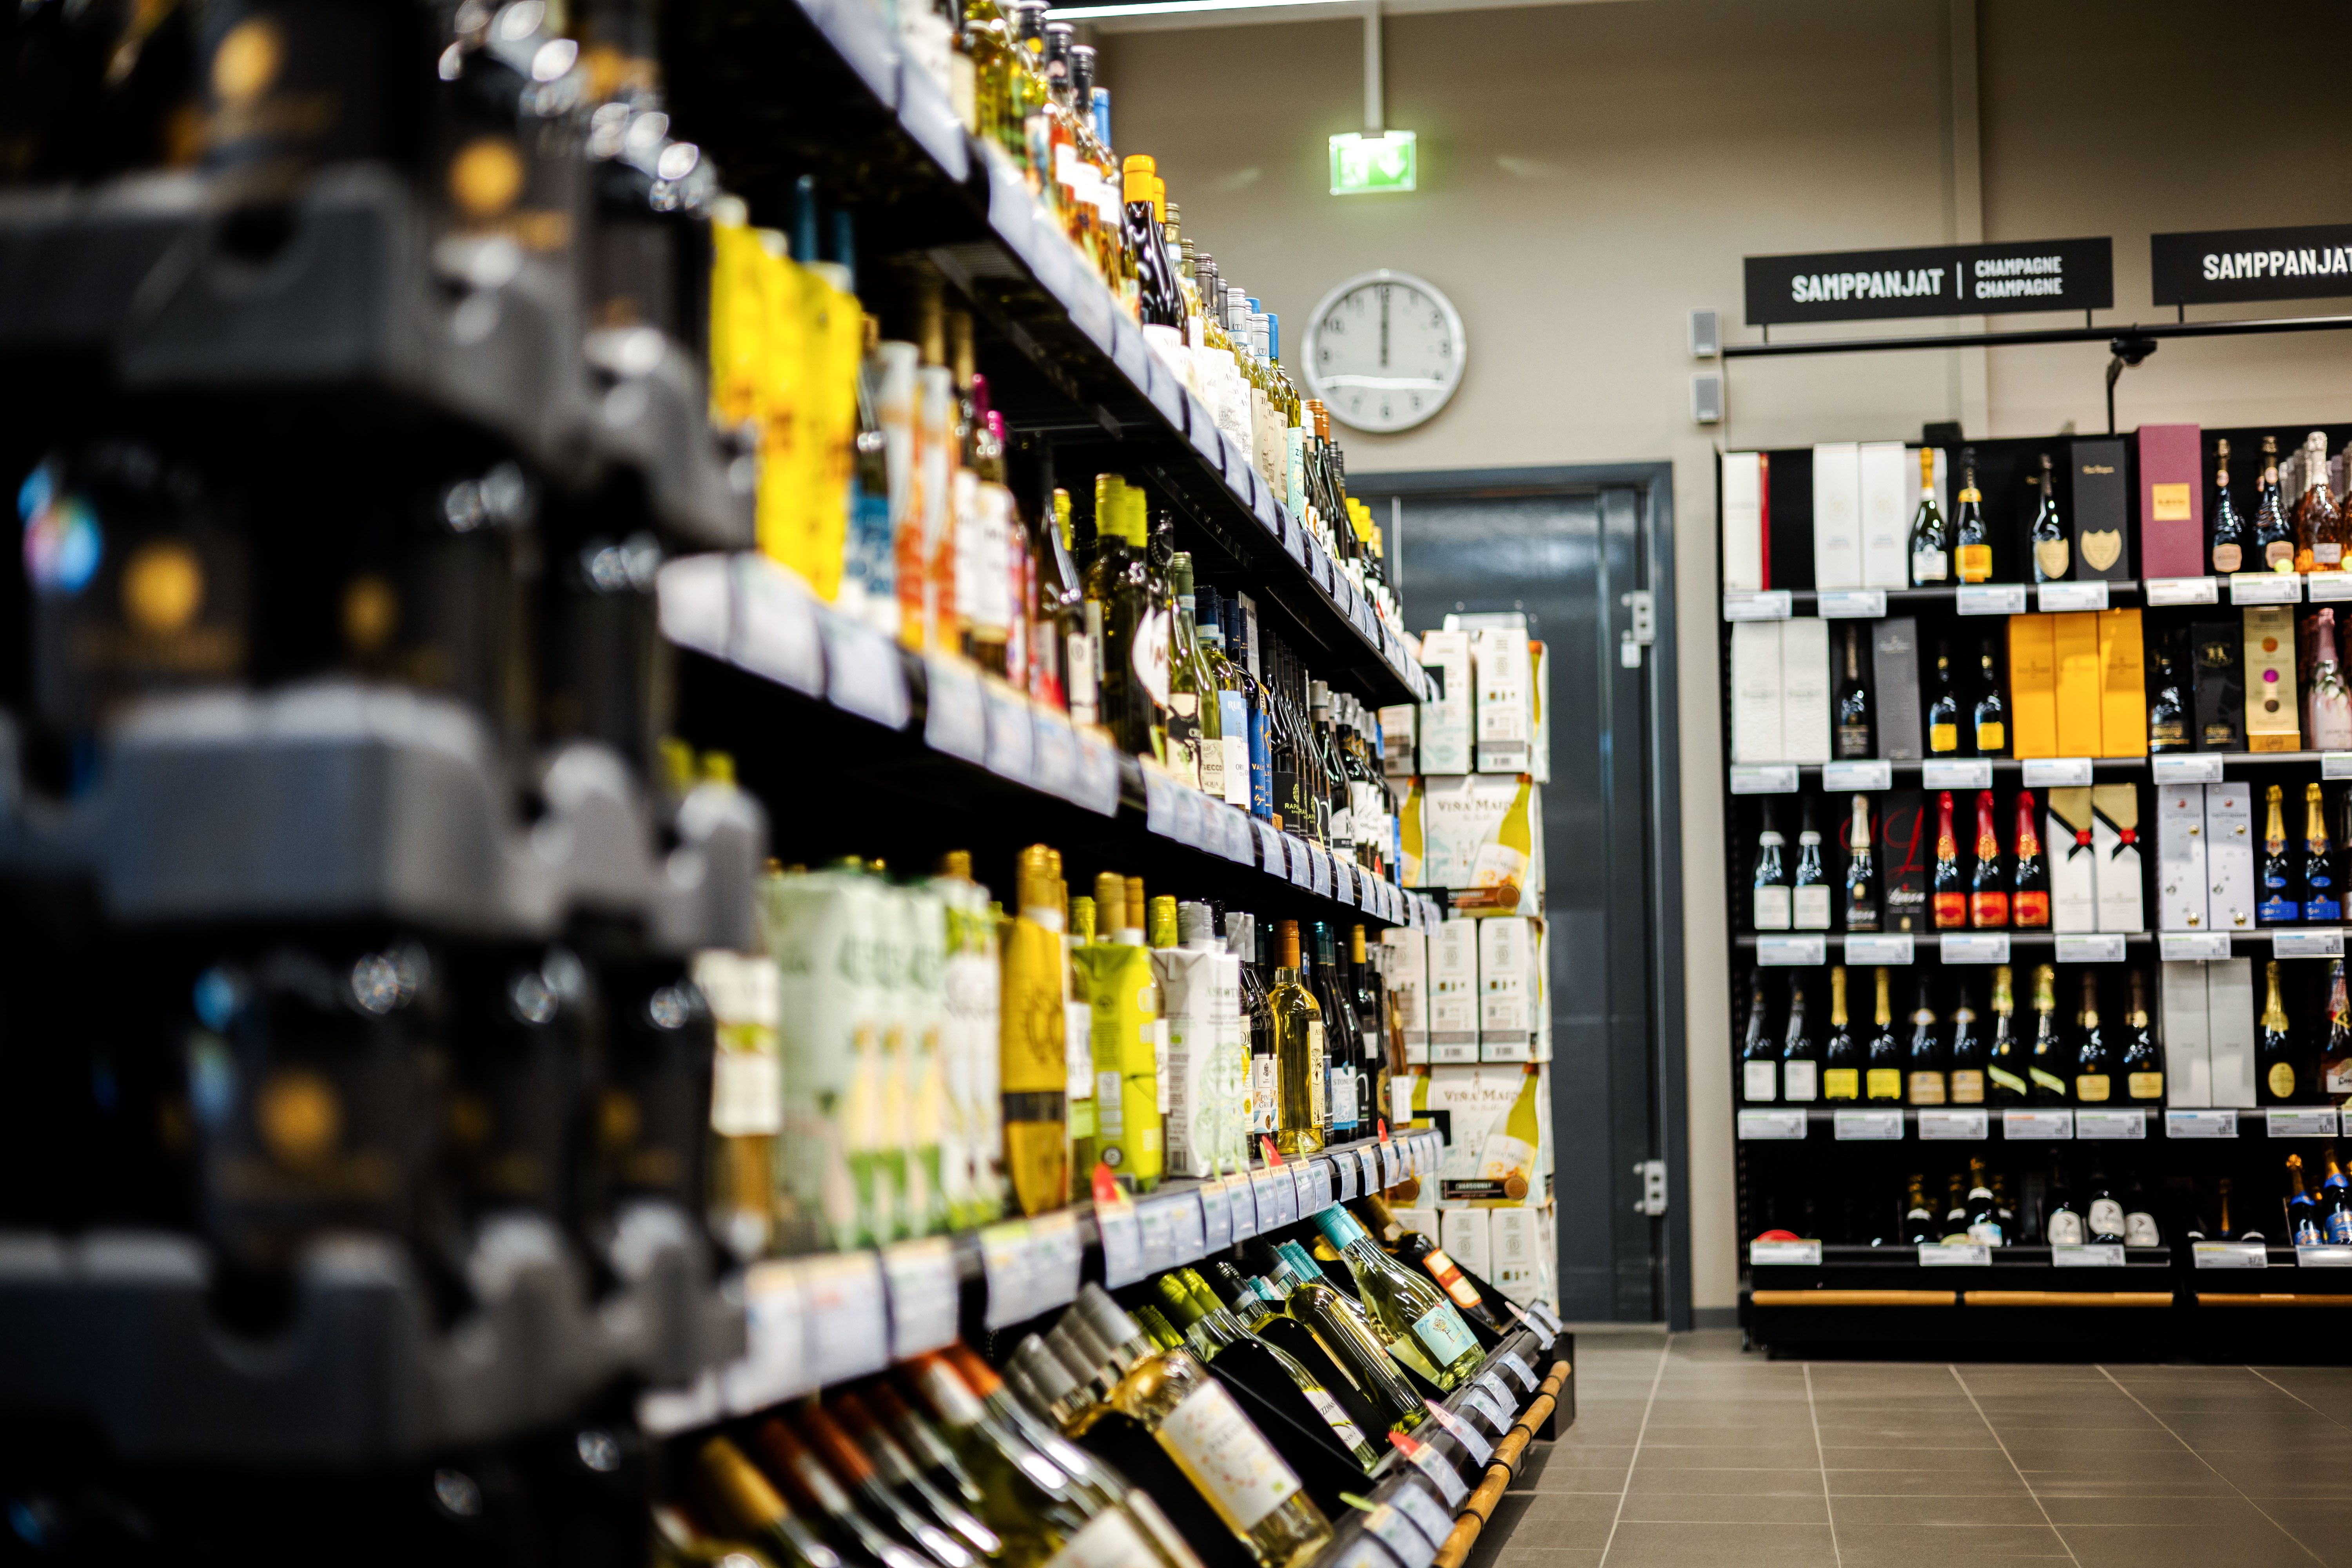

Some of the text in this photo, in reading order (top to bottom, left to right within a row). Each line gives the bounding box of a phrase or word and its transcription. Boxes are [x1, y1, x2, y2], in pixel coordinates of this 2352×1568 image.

[1975, 256, 2063, 278] CHAMPAGNE
[1791, 268, 1944, 303] SAMPPANJAT
[1975, 277, 2063, 299] CHAMPAGNE
